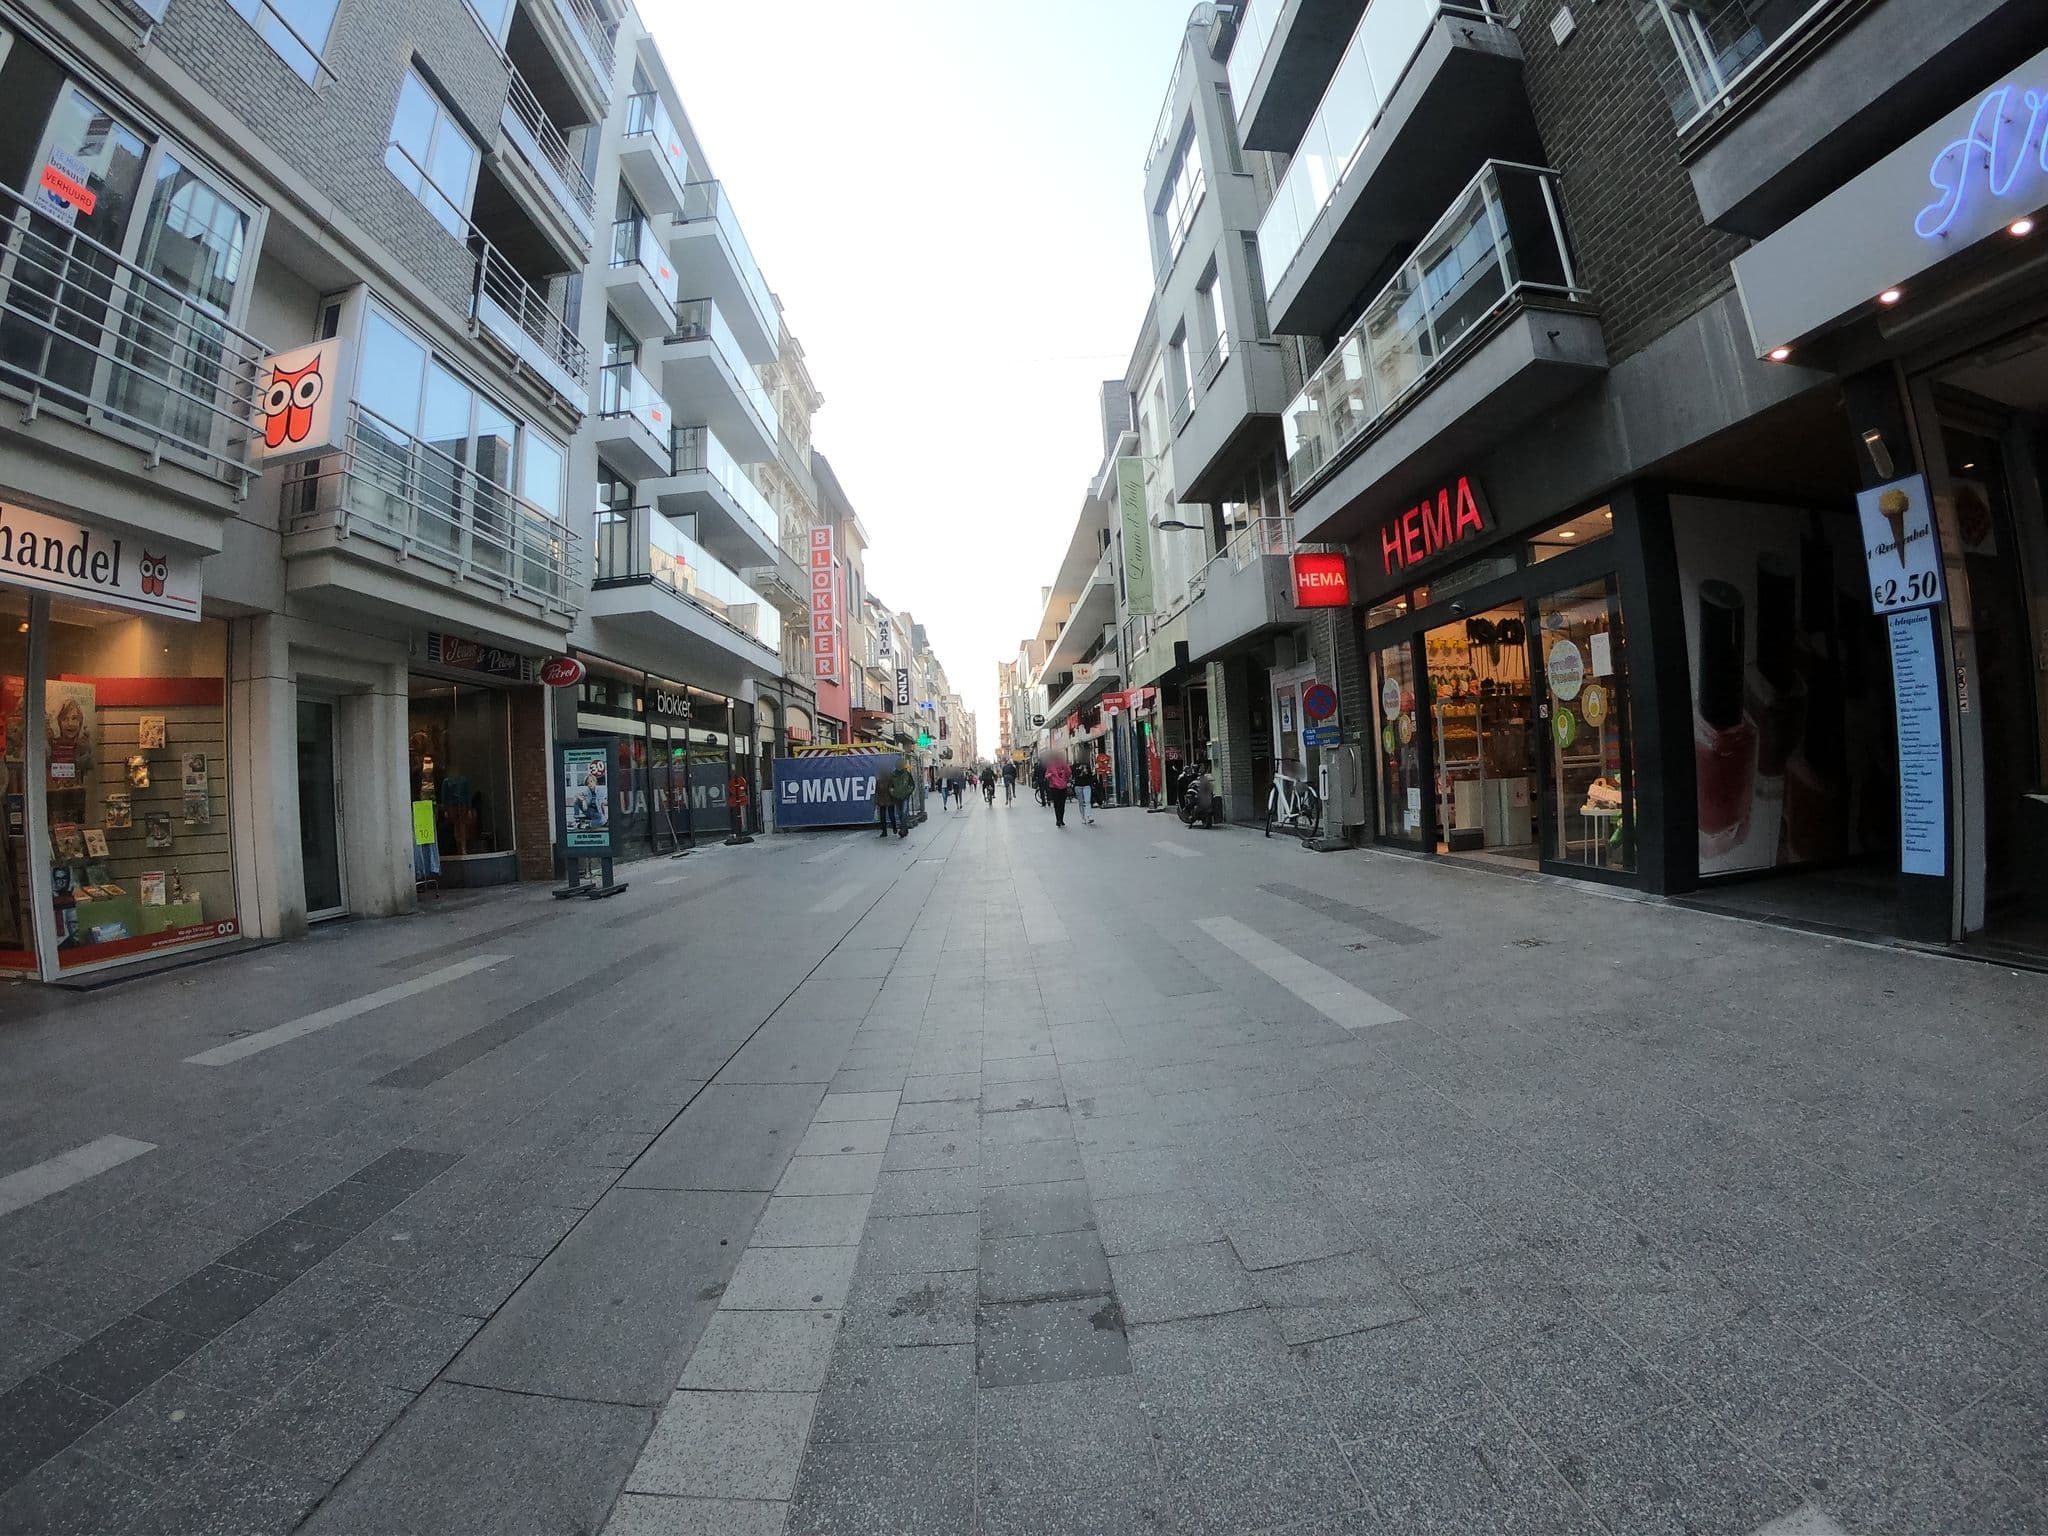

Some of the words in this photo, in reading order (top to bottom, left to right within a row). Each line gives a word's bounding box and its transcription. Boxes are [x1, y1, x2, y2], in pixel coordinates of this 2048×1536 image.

[46, 172, 92, 207] VERHUURD
[1380, 475, 1485, 576] HEMA
[1875, 523, 1930, 556] Reuenbol
[1298, 572, 1345, 588] HEMA
[1874, 570, 1937, 606] €2.50
[815, 530, 832, 674] BLOKKER
[878, 620, 890, 656] MAXIM
[547, 662, 577, 681] Petrol
[898, 671, 908, 704] ONLY
[657, 690, 691, 719] blokker
